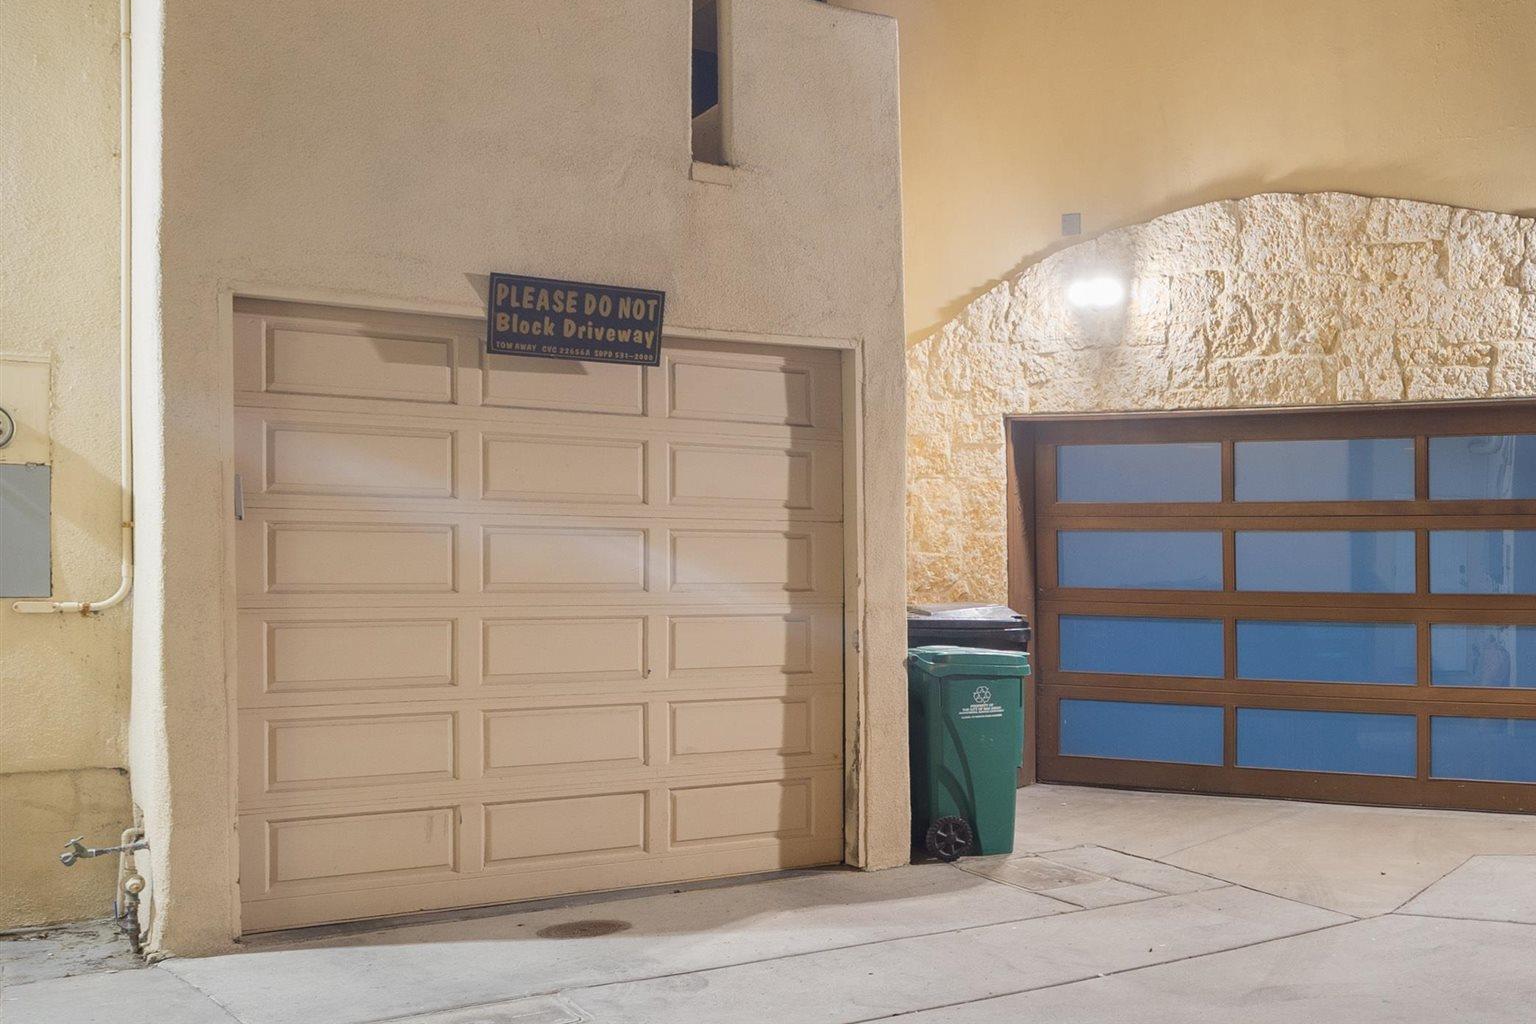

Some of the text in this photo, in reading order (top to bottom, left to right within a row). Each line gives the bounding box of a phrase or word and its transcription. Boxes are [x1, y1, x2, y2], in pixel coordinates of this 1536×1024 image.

[496, 283, 659, 322] PLEASE DO NOT
[496, 312, 655, 349] Block Driveway
[514, 342, 537, 352] AWAY
